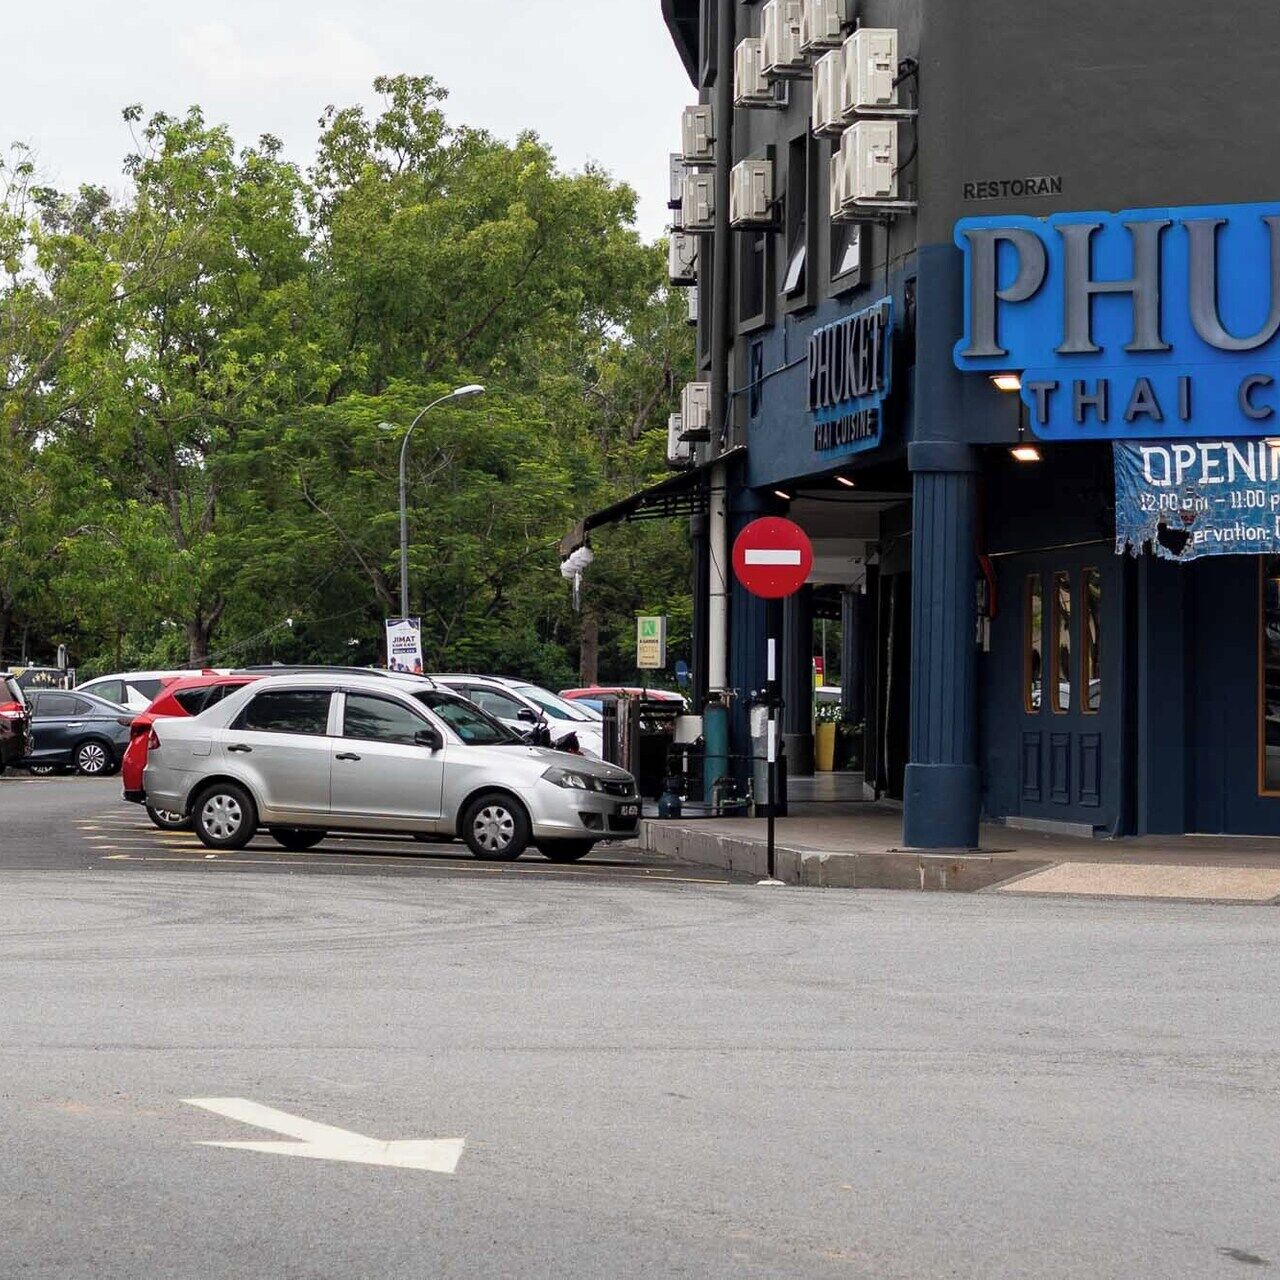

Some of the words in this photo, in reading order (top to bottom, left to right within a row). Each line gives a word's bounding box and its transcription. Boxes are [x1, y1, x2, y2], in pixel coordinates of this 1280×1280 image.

[963, 177, 1062, 199] RESTORAN
[807, 304, 888, 412] PHUKET
[1029, 376, 1191, 424] THAI
[835, 409, 873, 445] CUISINE
[1231, 490, 1265, 508] 11:00
